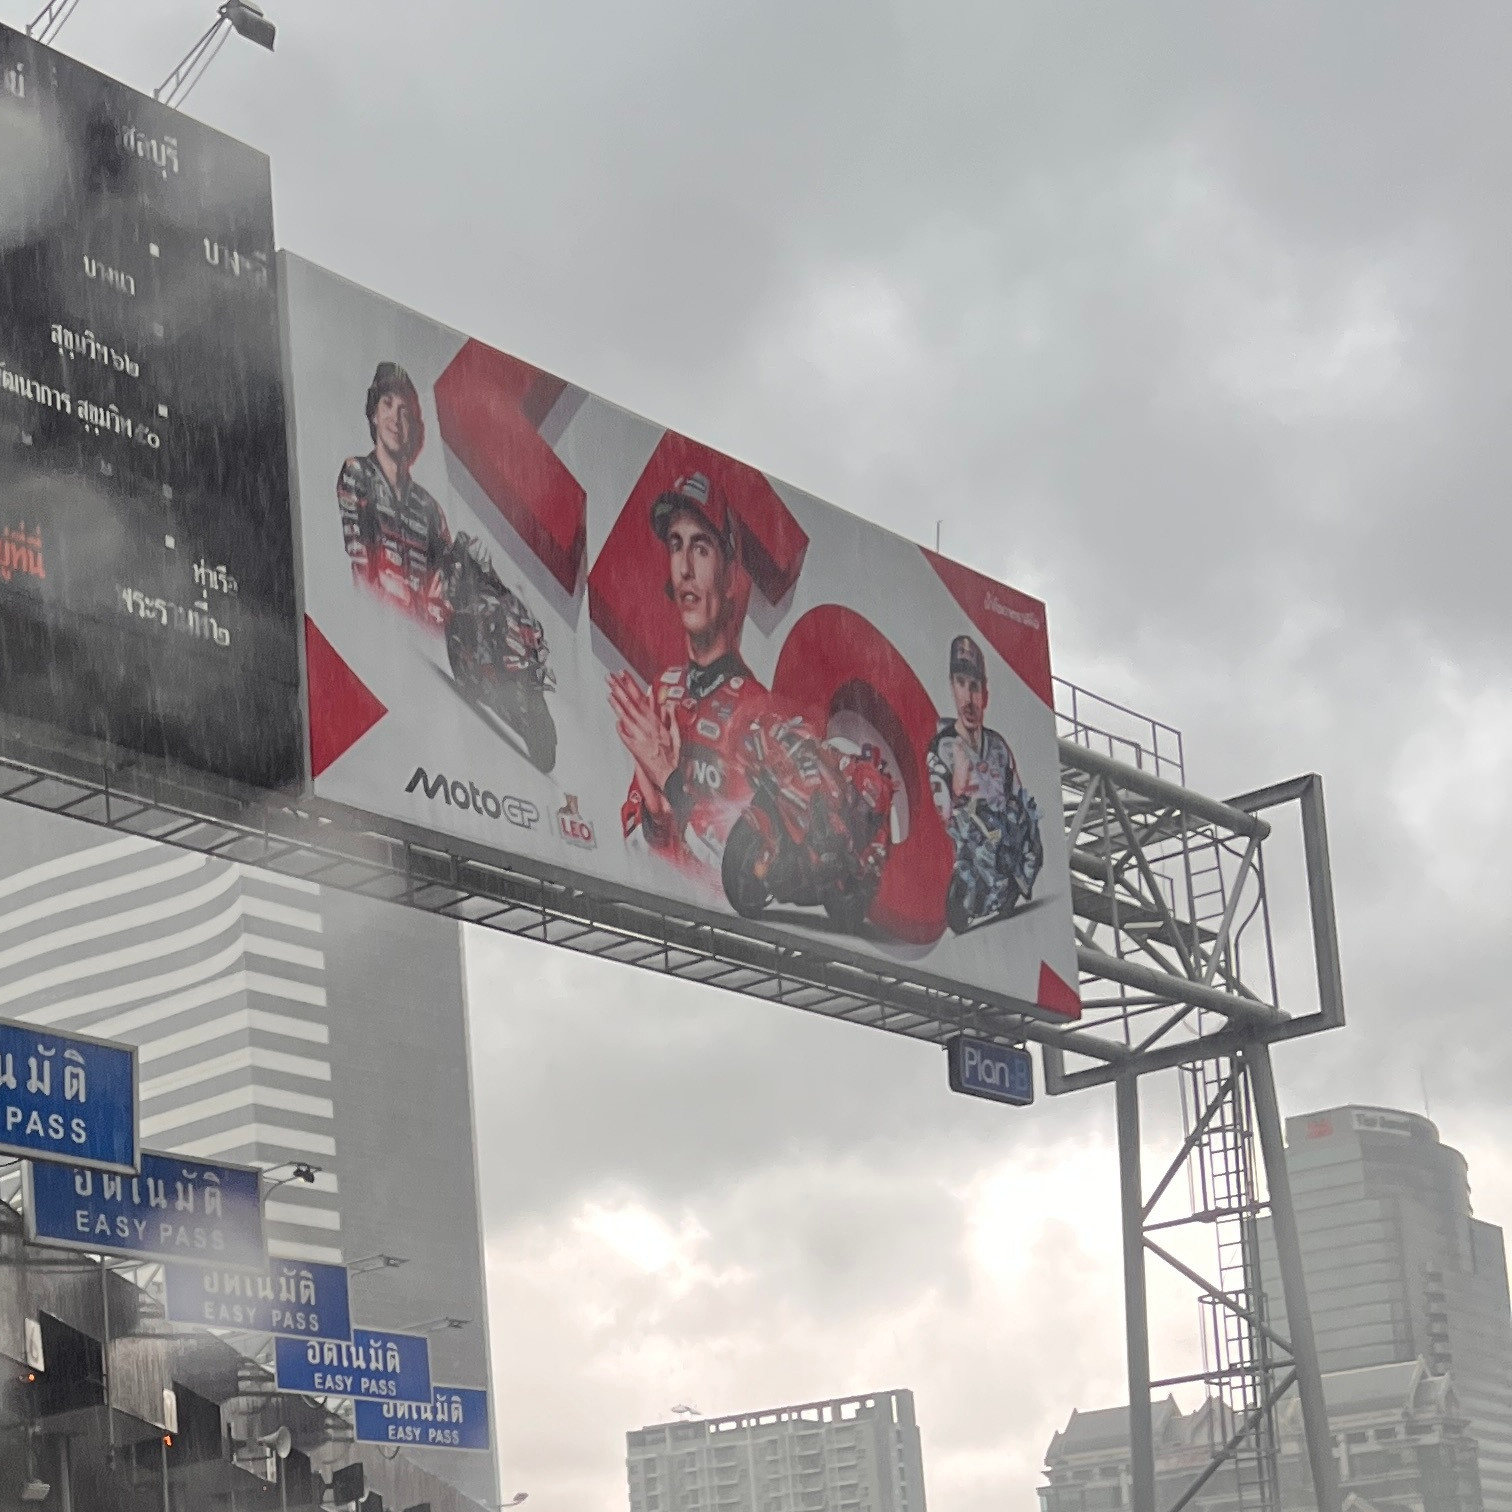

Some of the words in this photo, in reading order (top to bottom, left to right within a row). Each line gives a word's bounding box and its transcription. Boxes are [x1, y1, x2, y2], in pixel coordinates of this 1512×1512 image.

[560, 816, 592, 842] LEO
[964, 1046, 1010, 1088] Plan
[5, 1105, 87, 1145] PASS
[74, 1208, 147, 1241] EASY
[159, 1223, 225, 1250] PASS
[203, 1301, 257, 1325] EASY
[271, 1309, 319, 1332] PASS
[313, 1373, 354, 1393] EASY
[360, 1377, 398, 1398] PASS
[387, 1423, 422, 1442] EASY
[428, 1427, 460, 1445] PASS
